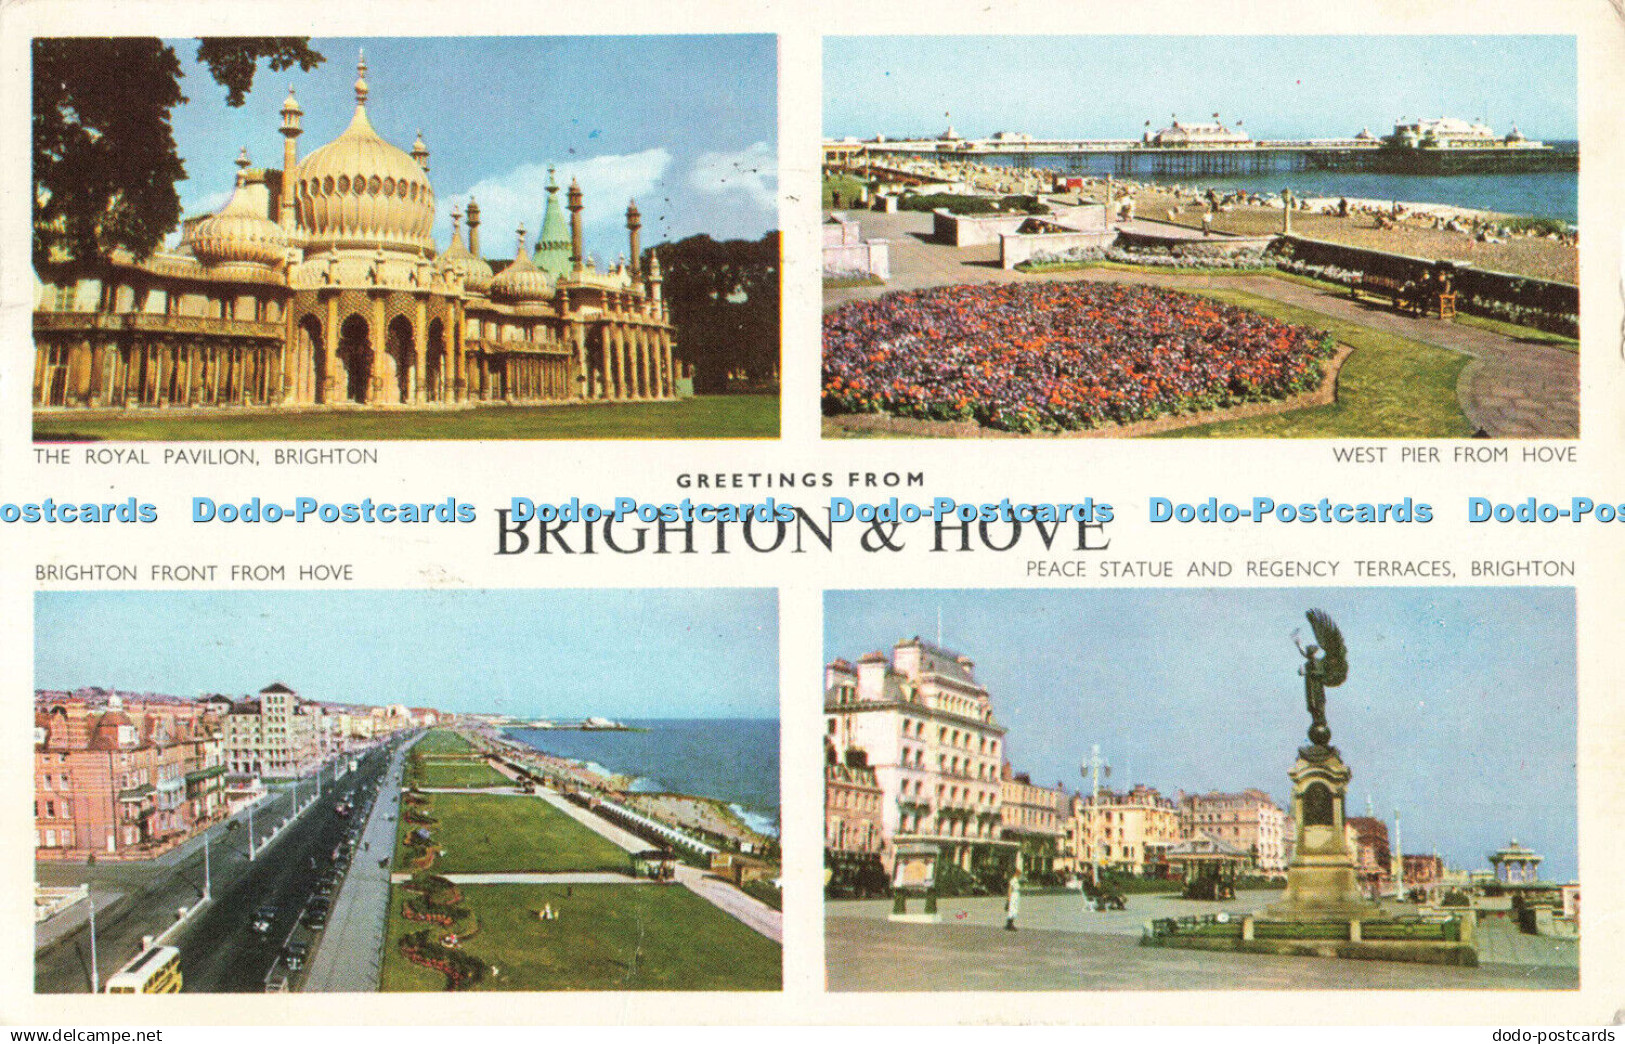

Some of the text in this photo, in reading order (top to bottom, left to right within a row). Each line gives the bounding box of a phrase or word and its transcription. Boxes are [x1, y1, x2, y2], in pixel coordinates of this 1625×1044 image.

[34, 448, 378, 467] THE ROYAL PAVILION, BRIGHTON
[1332, 446, 1577, 463] WEST PIER FROM HOVE
[676, 471, 924, 489] GREETINGS FROM
[494, 505, 1111, 555] BRIGHTON & HOVE
[35, 564, 353, 581] BRIGHTON FRONT FROM HOVE
[1027, 560, 1575, 578] PEACE STATUE AND REGENCY TERRACES, BRIGHTON
